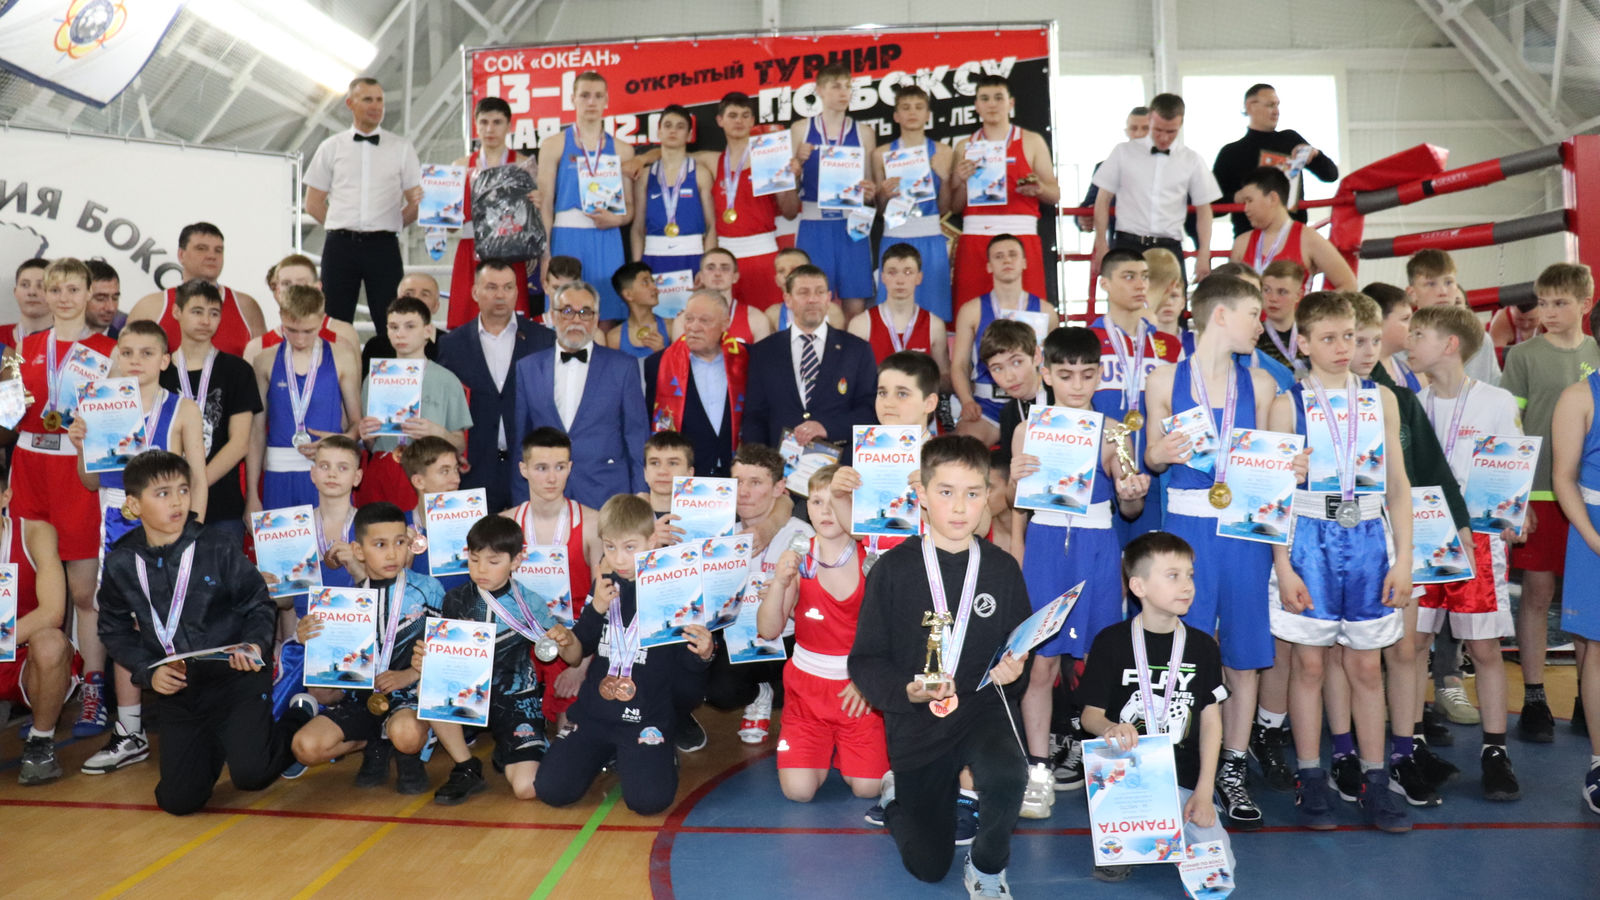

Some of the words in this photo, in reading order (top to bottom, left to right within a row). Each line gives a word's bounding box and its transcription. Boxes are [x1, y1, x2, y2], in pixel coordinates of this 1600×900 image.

[484, 54, 525, 73] СОК
[530, 50, 621, 70] «ОКЕАН»
[625, 62, 744, 94] ОТКРЫТЫЙ
[759, 82, 824, 123] ПО
[753, 145, 790, 157] ГРАМОТА
[822, 160, 861, 169] ГРАМОТА
[581, 170, 619, 179] ГРМОТА
[423, 178, 461, 187] ГРАМОТА
[658, 285, 691, 294] РАМОТА
[68, 363, 99, 381] ГРАМО
[372, 377, 418, 386] ГРАМОТА
[82, 400, 137, 412] ГРАМОТА
[1311, 412, 1378, 422] ГРМТА
[1030, 431, 1093, 447] ГРАМОТА
[858, 453, 915, 463] ГРАМОТА
[1230, 455, 1293, 471] ГРАМОТА
[1474, 458, 1530, 470] ГРАМОТА
[676, 498, 730, 508] ГРАМОТА
[430, 509, 483, 521] ГРАМОТА
[1413, 510, 1446, 520] МОТА
[258, 528, 311, 542] ГРАМОТА
[516, 565, 565, 575] ГРАМОТА
[703, 559, 747, 572] РАМОТА
[641, 567, 698, 585] ГРАМОТА
[312, 611, 371, 623] ГРАМОТА
[428, 643, 488, 659] ГРАМОТА
[1098, 818, 1176, 834] ГРАМОТА
